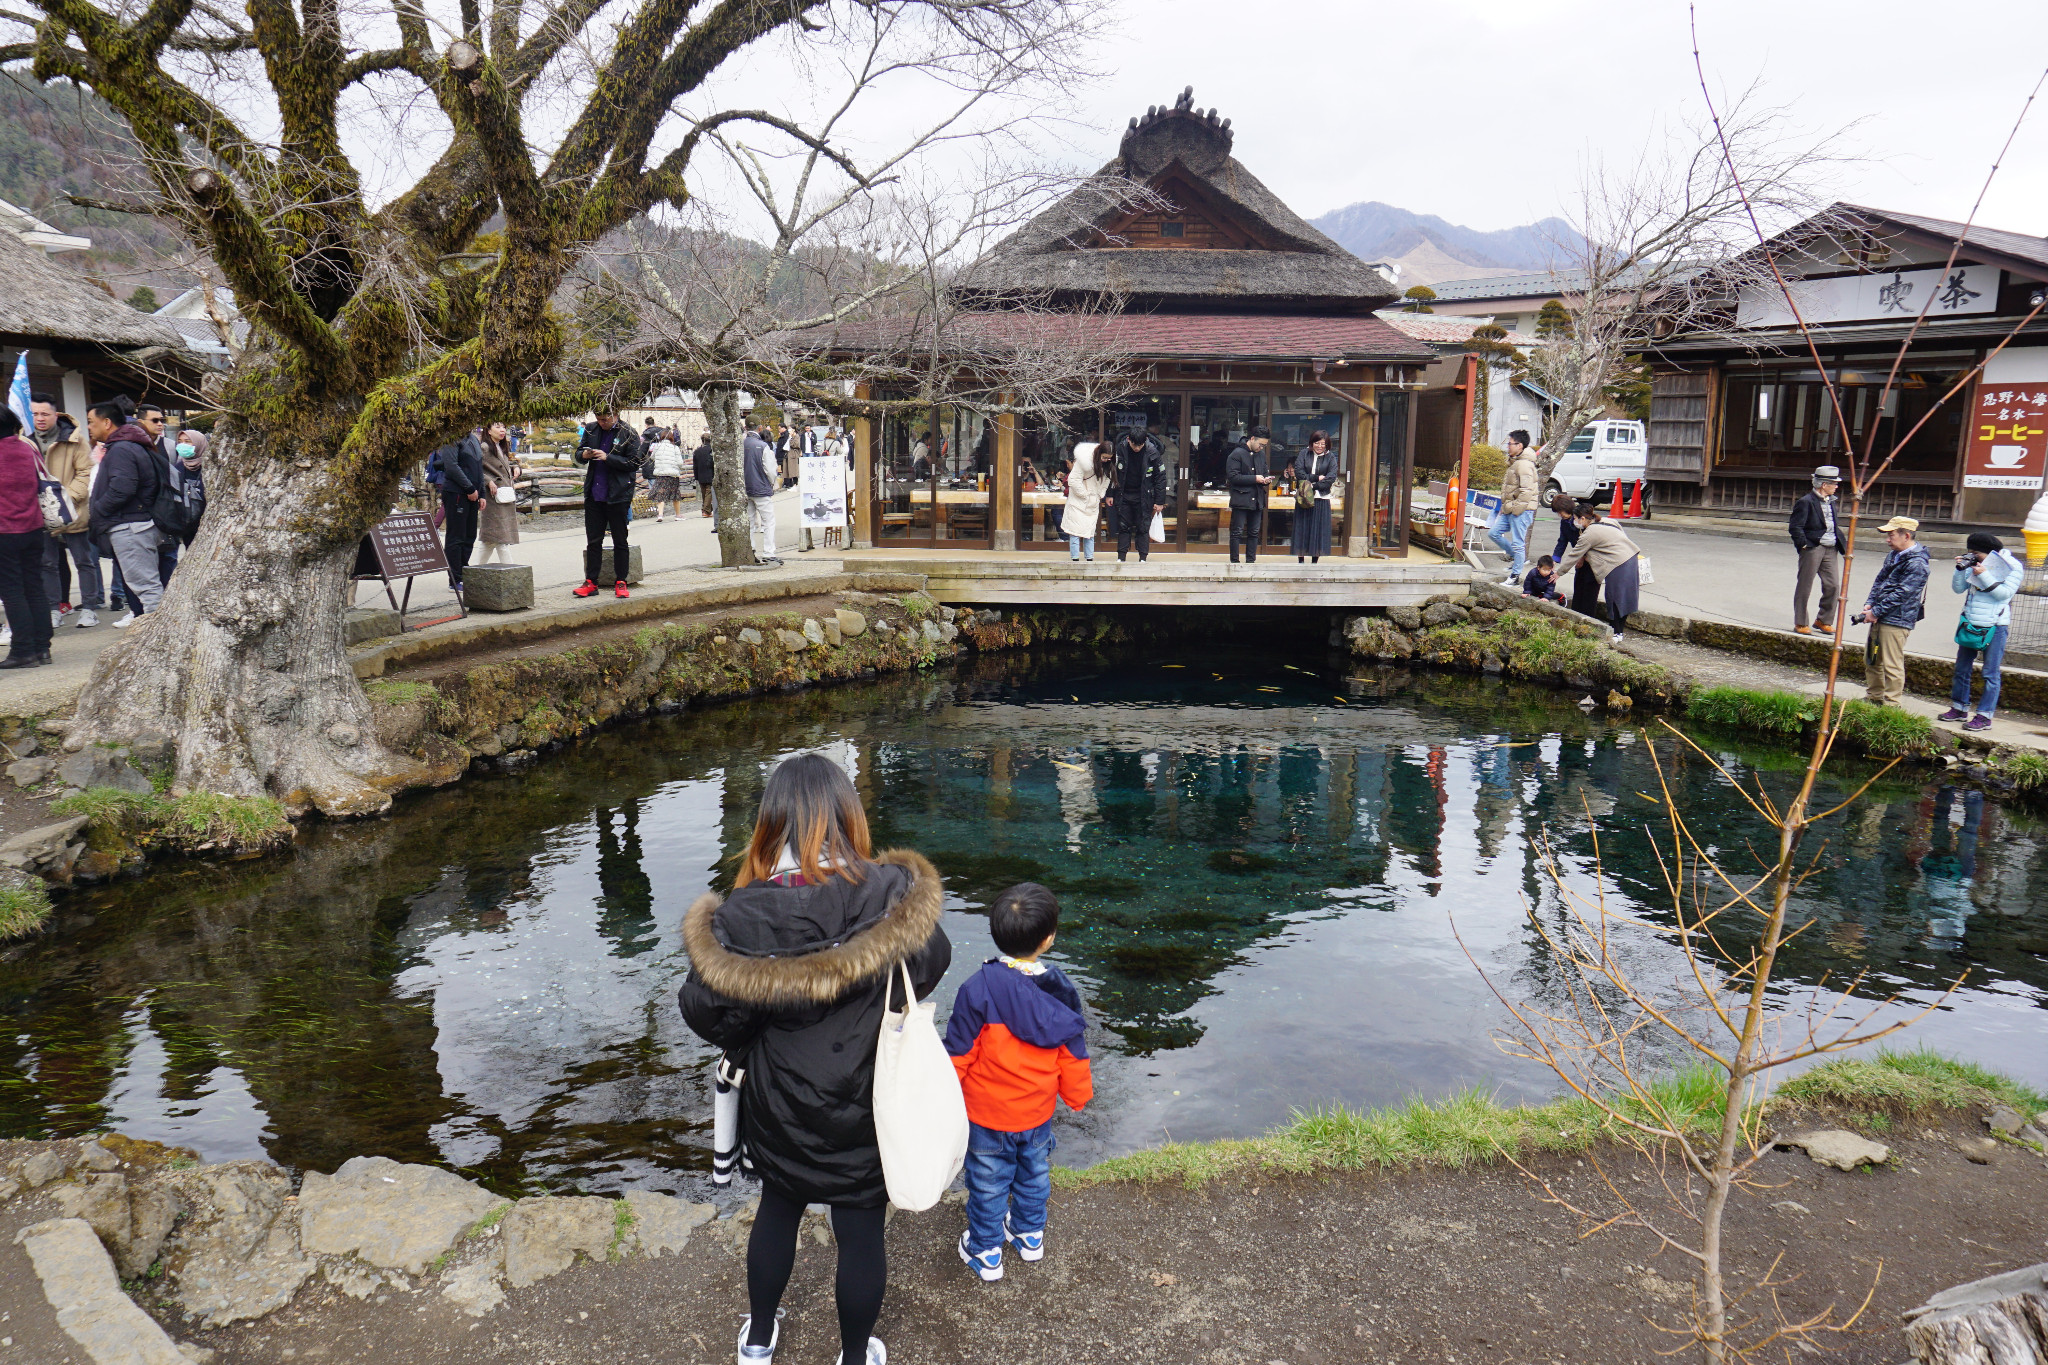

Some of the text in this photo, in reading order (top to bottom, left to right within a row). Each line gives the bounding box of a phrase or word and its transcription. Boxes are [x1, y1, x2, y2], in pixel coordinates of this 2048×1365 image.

[1879, 269, 1982, 313] 喫茶
[1982, 390, 2048, 407] 忍野八海
[1979, 423, 2044, 441] コーヒー
